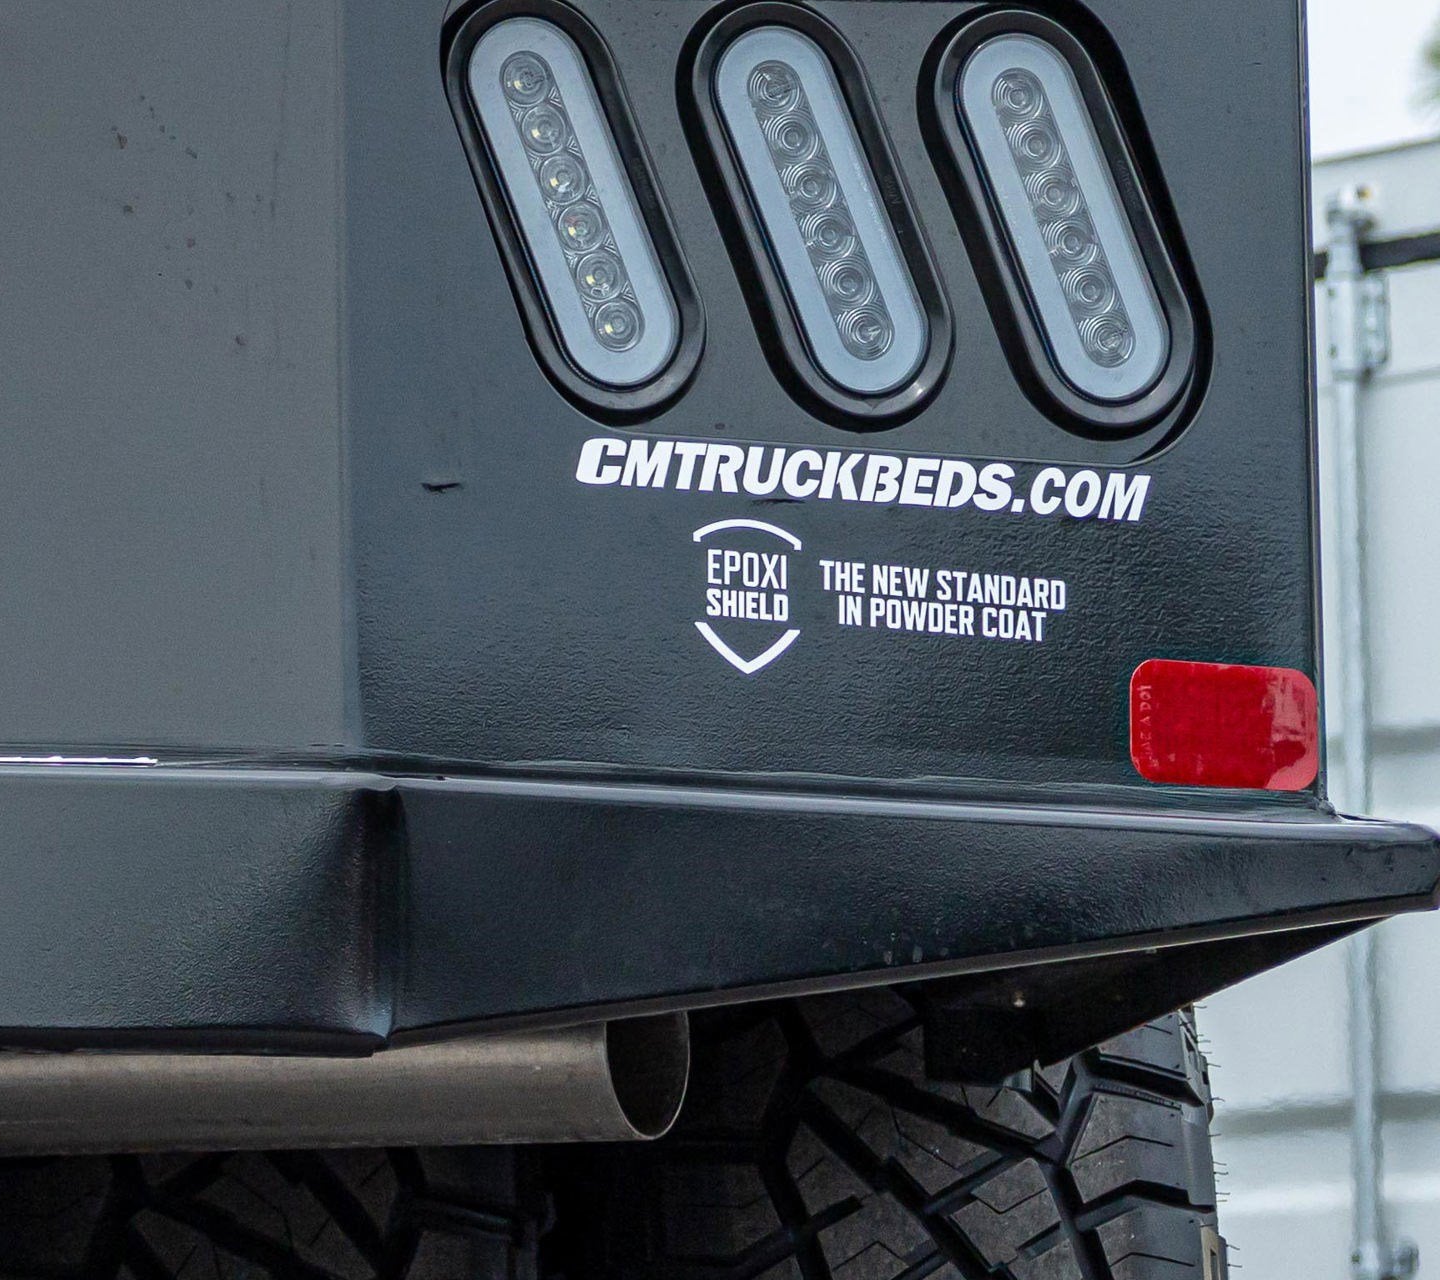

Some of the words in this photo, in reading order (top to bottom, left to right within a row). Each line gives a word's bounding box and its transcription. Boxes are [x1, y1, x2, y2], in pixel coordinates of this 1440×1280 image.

[575, 436, 1152, 522] CMTRUCKBEDS.COM
[707, 548, 787, 590] EPOXI
[819, 559, 866, 594] THE
[872, 564, 930, 599] NEW
[936, 570, 1066, 610] STANDARD
[706, 588, 789, 622] SHIELD
[838, 595, 862, 626] IN
[870, 597, 975, 636] POWDER
[982, 607, 1047, 642] COAT
